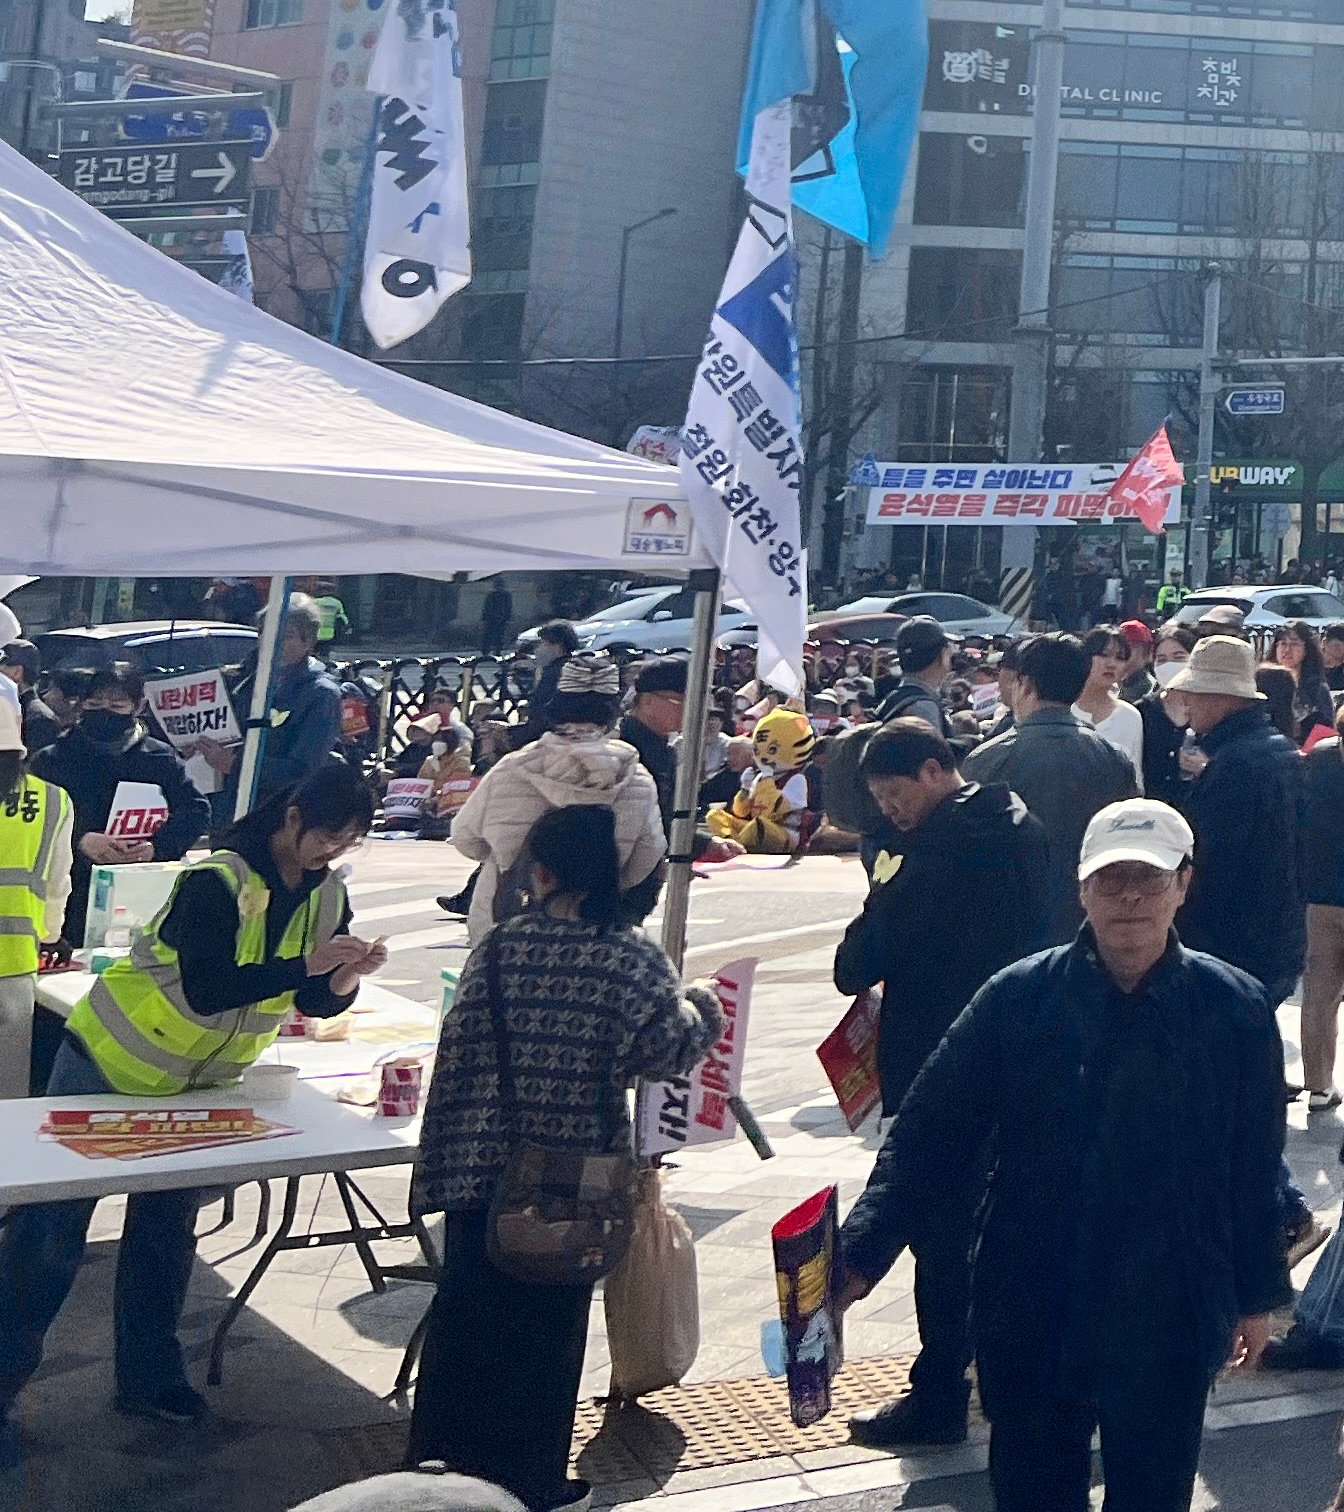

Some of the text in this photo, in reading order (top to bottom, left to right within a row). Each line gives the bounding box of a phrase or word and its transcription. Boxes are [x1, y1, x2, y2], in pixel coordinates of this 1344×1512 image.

[1202, 56, 1241, 87] 참빛
[1018, 84, 1162, 104] DTAL CLINIC
[1197, 83, 1238, 107] 치과
[74, 152, 179, 187] 감고당길
[703, 330, 802, 492] 원특별자
[931, 468, 978, 489] 주면
[981, 468, 1074, 489] 살아난다
[1210, 466, 1296, 486] UBWAY
[877, 492, 1172, 519] 윤석열을 즉각 파면하
[155, 679, 218, 711] 내란세력
[162, 705, 228, 736] 제압하자!
